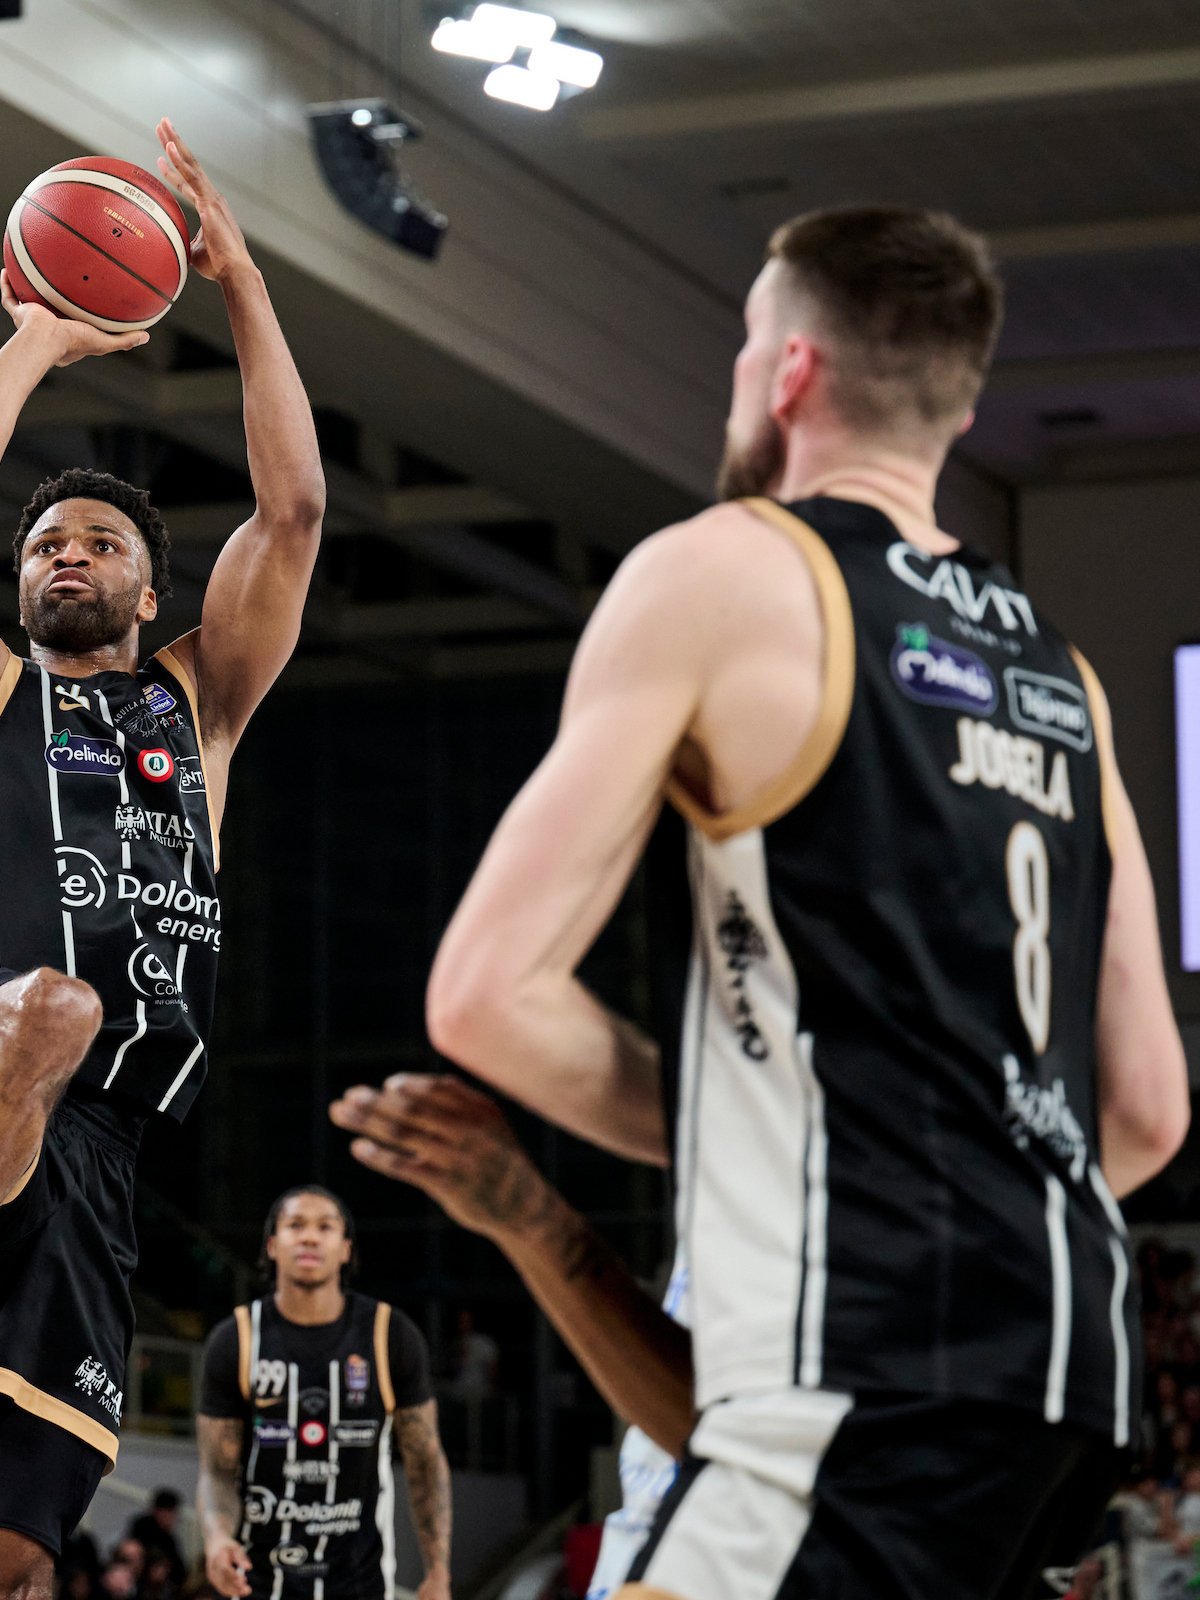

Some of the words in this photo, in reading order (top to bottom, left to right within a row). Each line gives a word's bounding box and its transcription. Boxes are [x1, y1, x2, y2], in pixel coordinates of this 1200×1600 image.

[103, 206, 145, 239] COMPETITION
[50, 745, 121, 767] Melinda
[117, 873, 221, 922] Dolom
[1005, 820, 1051, 1055] 8
